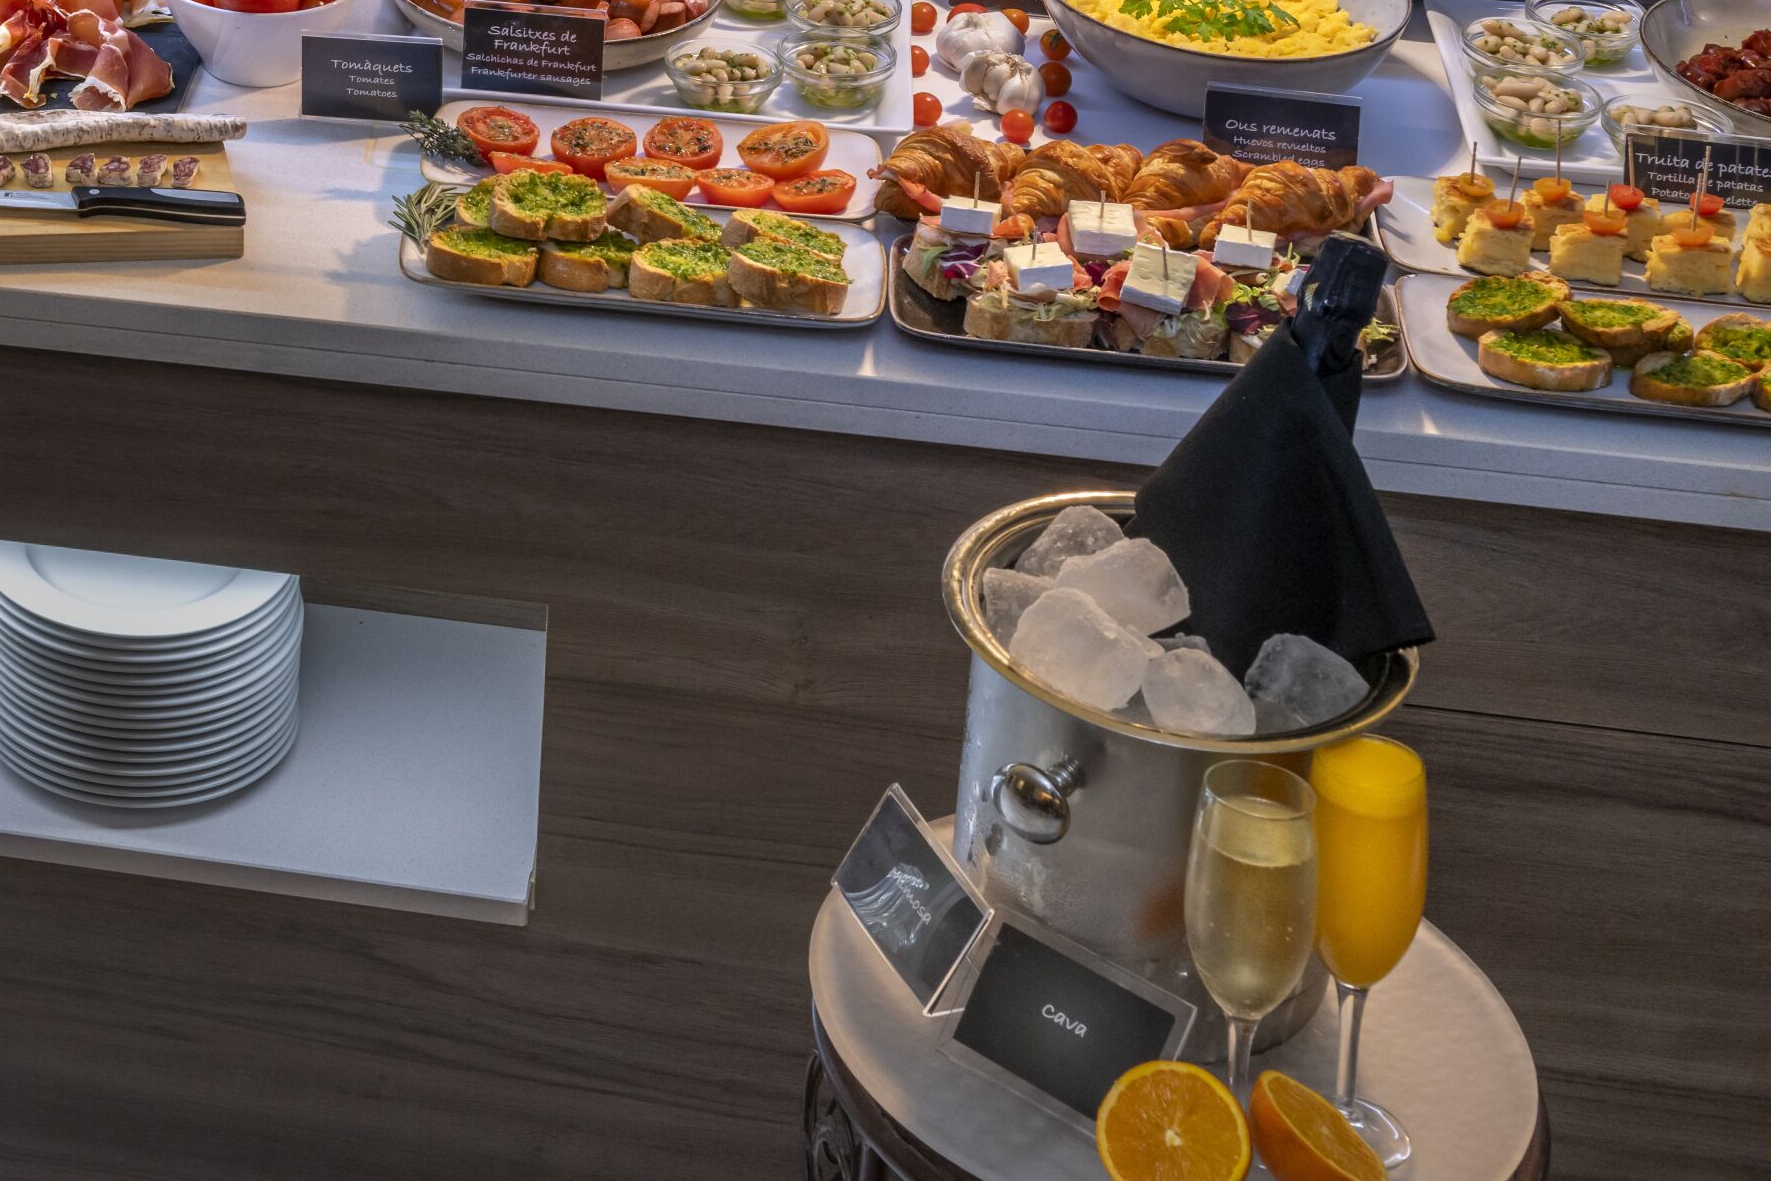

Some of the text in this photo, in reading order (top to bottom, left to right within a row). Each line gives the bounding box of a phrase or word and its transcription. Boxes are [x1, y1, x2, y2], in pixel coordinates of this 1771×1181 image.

[487, 25, 577, 43] Salsitxes de
[494, 39, 571, 57] Frankfurt
[330, 59, 413, 76] Tomàquets
[466, 53, 597, 73] Salchichas de Frankfurt
[348, 75, 395, 85] Tomates
[471, 66, 591, 87] Frankfurter sausages
[346, 87, 398, 98] Tomatoes
[1225, 119, 1337, 140] Ous remenats
[1233, 135, 1326, 154] Huevos revueltos
[1297, 157, 1325, 167] eggs
[1635, 152, 1689, 169] Truita
[1717, 162, 1771, 178] patate
[1647, 171, 1695, 184] Tortilla
[1716, 180, 1764, 193] patatas
[1651, 187, 1691, 200] Potato
